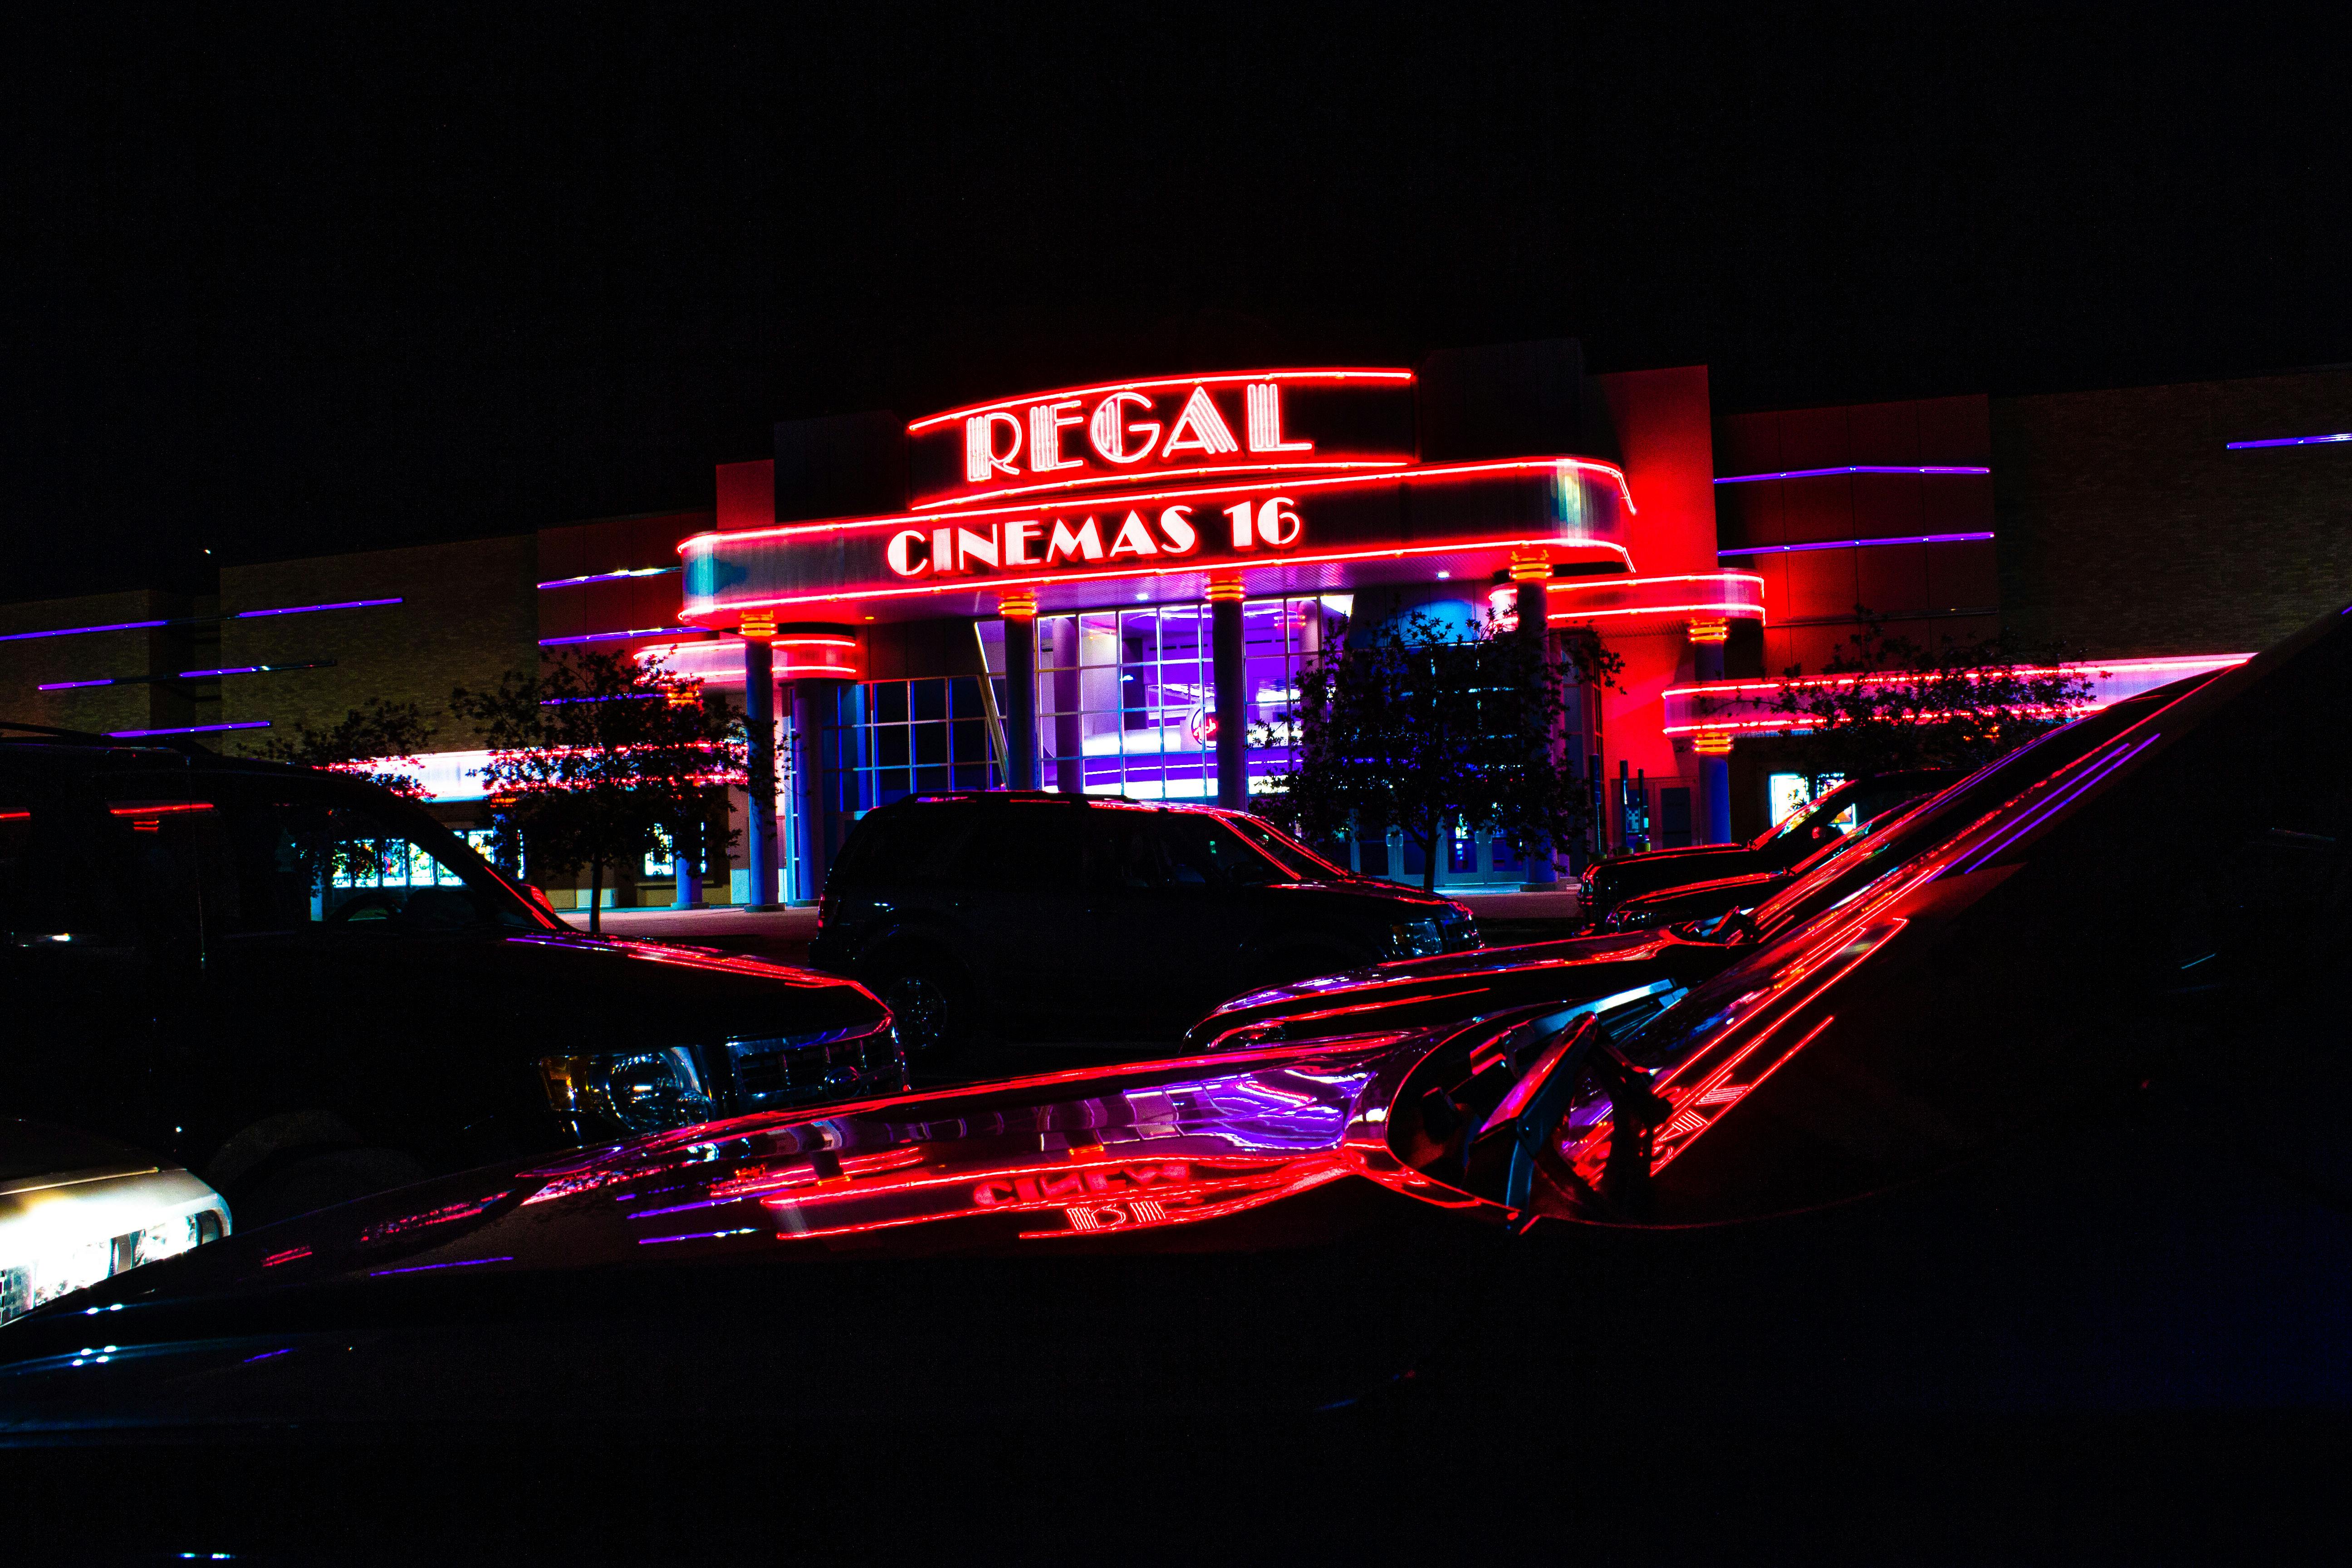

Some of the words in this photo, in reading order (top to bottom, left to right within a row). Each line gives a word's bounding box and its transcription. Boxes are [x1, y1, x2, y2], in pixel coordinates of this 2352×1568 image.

[966, 383, 1313, 483] REGAL
[887, 505, 1196, 576] CINEMAS
[1223, 497, 1300, 547] 16
